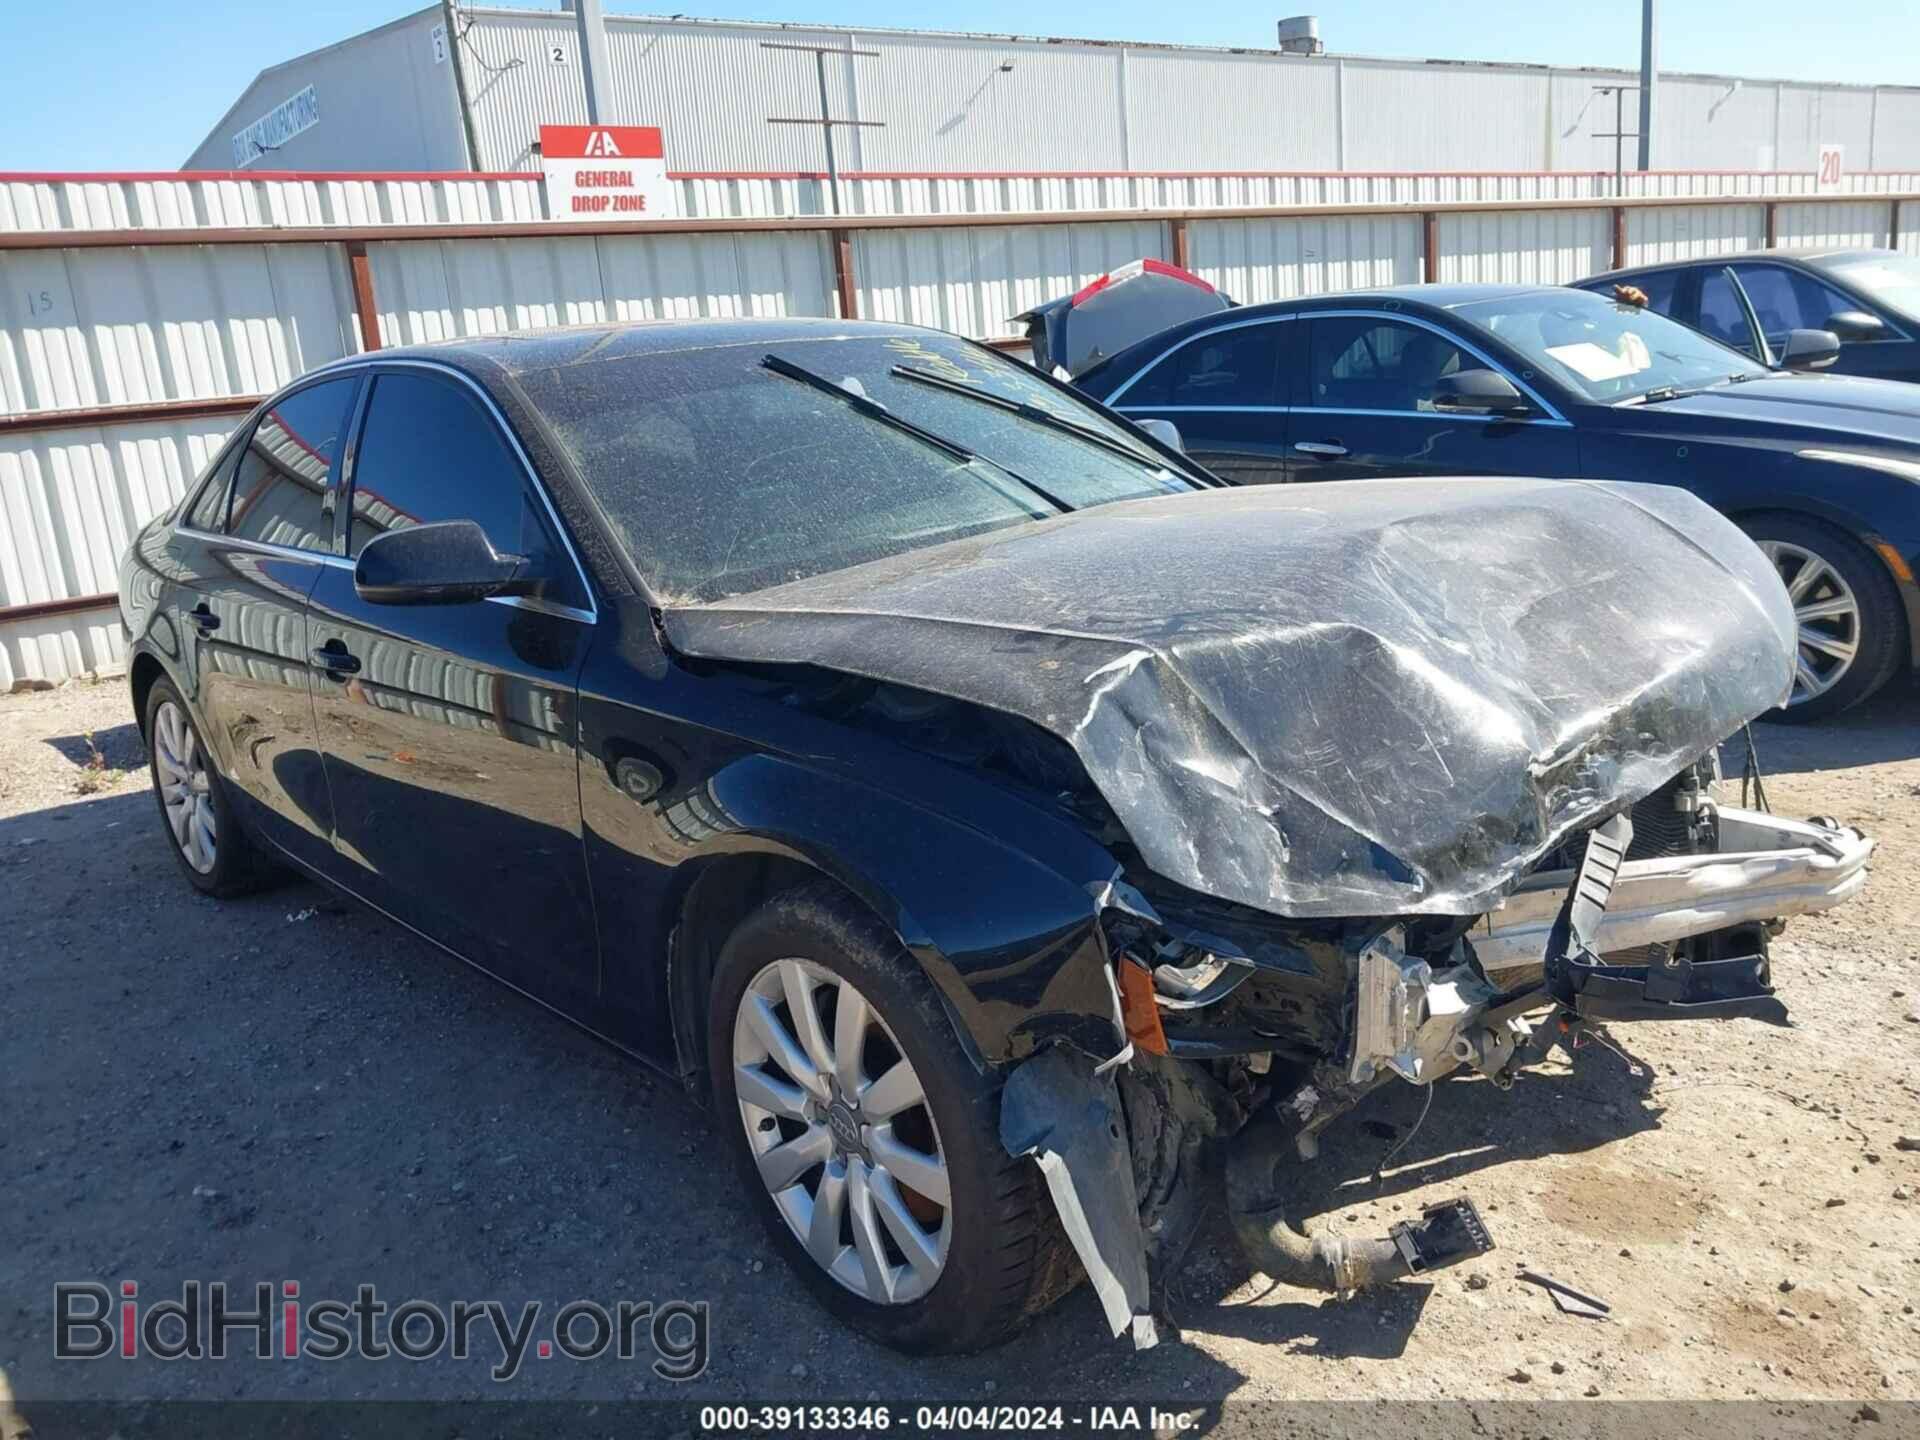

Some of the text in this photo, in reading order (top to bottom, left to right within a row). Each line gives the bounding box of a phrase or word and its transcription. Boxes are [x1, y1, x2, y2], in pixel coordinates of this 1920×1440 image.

[553, 48, 564, 61] 2
[1820, 151, 1841, 185] 20
[575, 170, 634, 188] GENERAL
[571, 194, 646, 213] DROP ZONE
